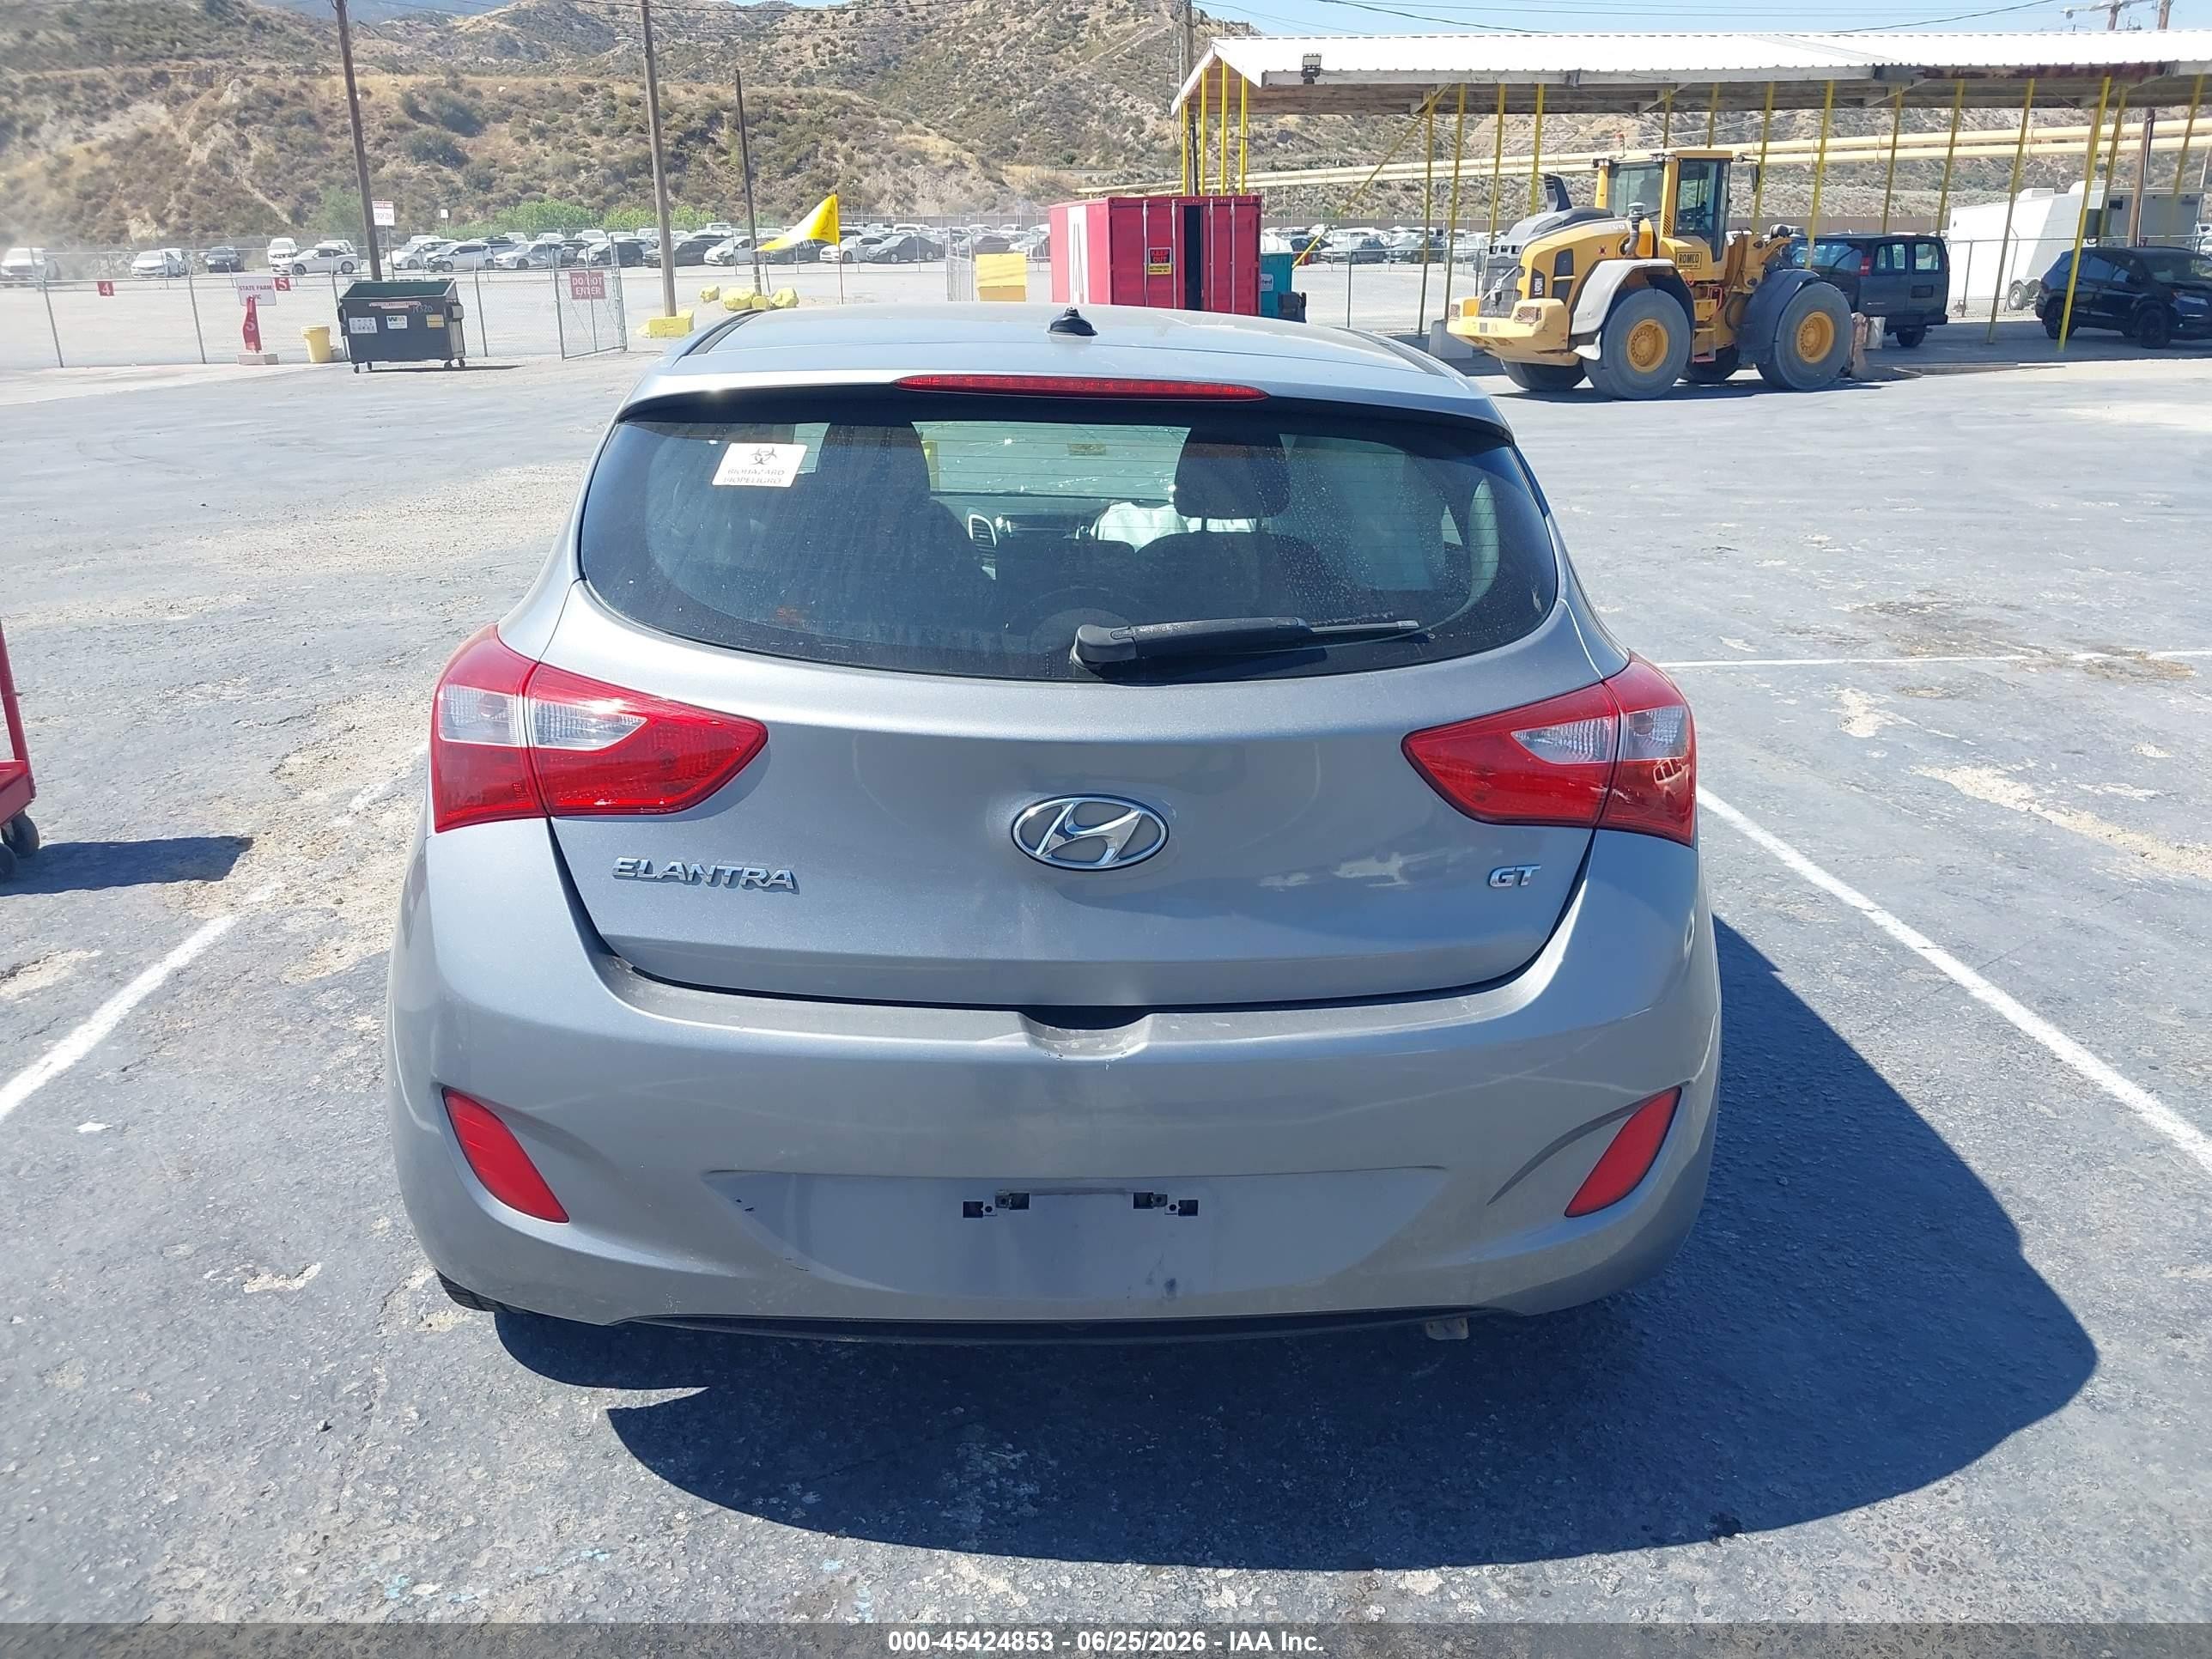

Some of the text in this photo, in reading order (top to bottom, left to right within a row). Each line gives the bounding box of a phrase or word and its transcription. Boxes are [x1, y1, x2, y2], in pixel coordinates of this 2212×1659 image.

[277, 277, 288, 289] 5
[572, 276, 584, 285] DO
[102, 283, 111, 295] 4
[575, 287, 601, 295] ENTER
[611, 856, 795, 890] ELANTRA
[1488, 864, 1542, 888] GT
